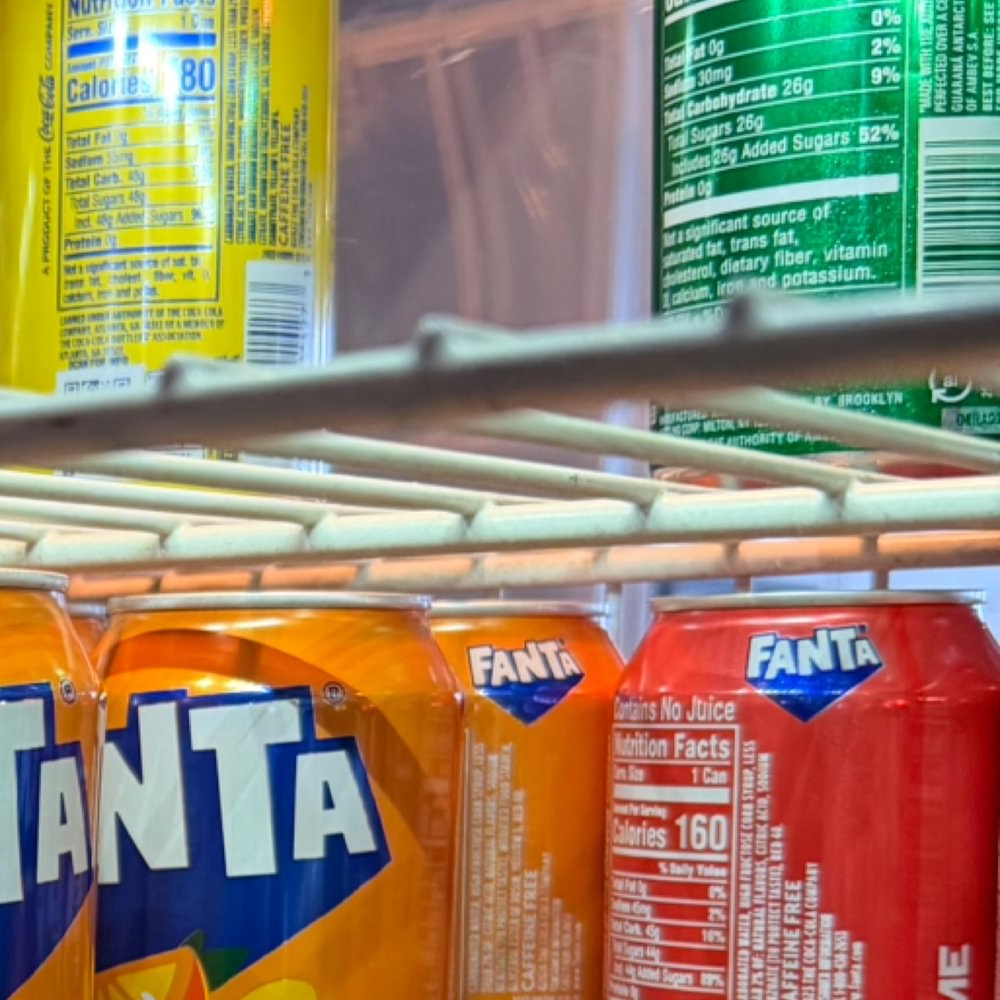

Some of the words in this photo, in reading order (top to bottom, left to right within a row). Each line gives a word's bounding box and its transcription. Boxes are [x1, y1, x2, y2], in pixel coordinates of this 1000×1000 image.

[870, 8, 901, 28] 0%
[983, 1, 995, 25] SEE
[708, 39, 725, 58] 0g
[870, 37, 901, 57] 2%
[934, 24, 948, 52] OVER
[697, 65, 733, 87] 30mg
[870, 66, 901, 85] 9%
[934, 54, 948, 113] PERFECTED
[965, 54, 979, 94] AMBEV
[67, 75, 151, 104] Calories
[686, 83, 778, 118] Carbohydrate
[782, 77, 814, 97] 26g
[982, 81, 994, 112] BEST
[965, 96, 978, 113] OF
[279, 123, 290, 164] FREE
[690, 120, 733, 147] Sugars
[736, 114, 765, 134] 26g
[712, 145, 738, 166] 26g
[741, 138, 788, 160] Added
[792, 129, 851, 152] Sugars
[858, 123, 901, 145] 52%
[278, 169, 290, 247] CAFFEINE
[685, 216, 749, 241] significant
[752, 207, 807, 229] source
[812, 202, 832, 221] of
[730, 234, 770, 253] trans
[773, 228, 800, 248] fat,
[720, 254, 770, 275] dietary
[773, 249, 818, 268] fiber,
[823, 241, 889, 262] vitamin
[782, 265, 877, 290] potassium.
[838, 392, 904, 407] BROOKLYN
[727, 431, 784, 448] AUTHORITY
[468, 640, 581, 689] FANTA
[747, 626, 881, 680] FANTA
[660, 696, 682, 721] No
[687, 695, 736, 721] Juice
[614, 731, 668, 758] Nutrition
[673, 732, 731, 759] Facts
[742, 740, 756, 765] LESS
[703, 766, 728, 785] Can
[614, 818, 667, 848] Calories
[674, 812, 728, 851] 160
[523, 869, 537, 911] FREE
[783, 879, 802, 926] FREE
[520, 913, 536, 992] CAFFEINE
